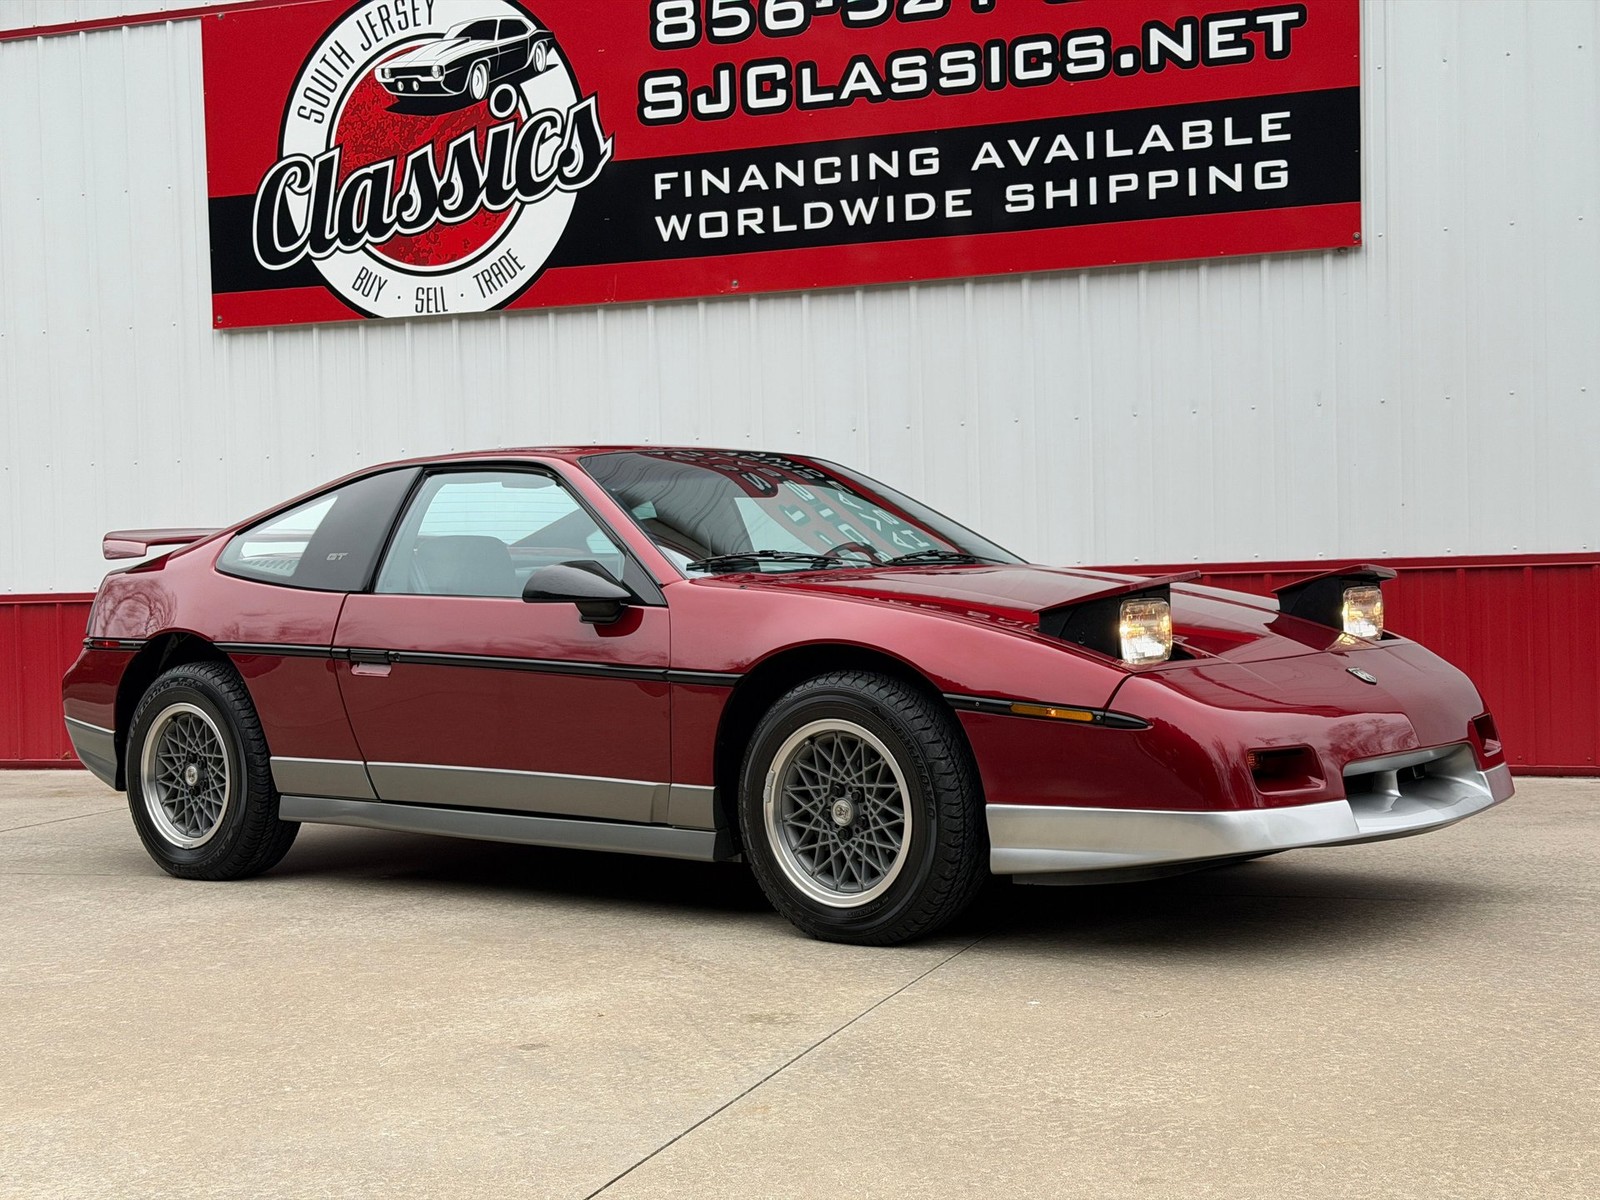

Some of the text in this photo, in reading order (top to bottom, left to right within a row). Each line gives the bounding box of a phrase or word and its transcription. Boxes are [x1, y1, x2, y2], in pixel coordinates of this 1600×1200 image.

[297, 0, 435, 124] SOUTH JERSEY
[643, 12, 1299, 119] SJCLASSICS.NET
[252, 83, 614, 270] Classics
[654, 111, 1292, 200] FINANCING AVAILABLE
[654, 160, 1289, 242] WORLDWIDE SHIPPING
[352, 248, 526, 313] BUY SELL TRADE
[326, 552, 349, 561] GT
